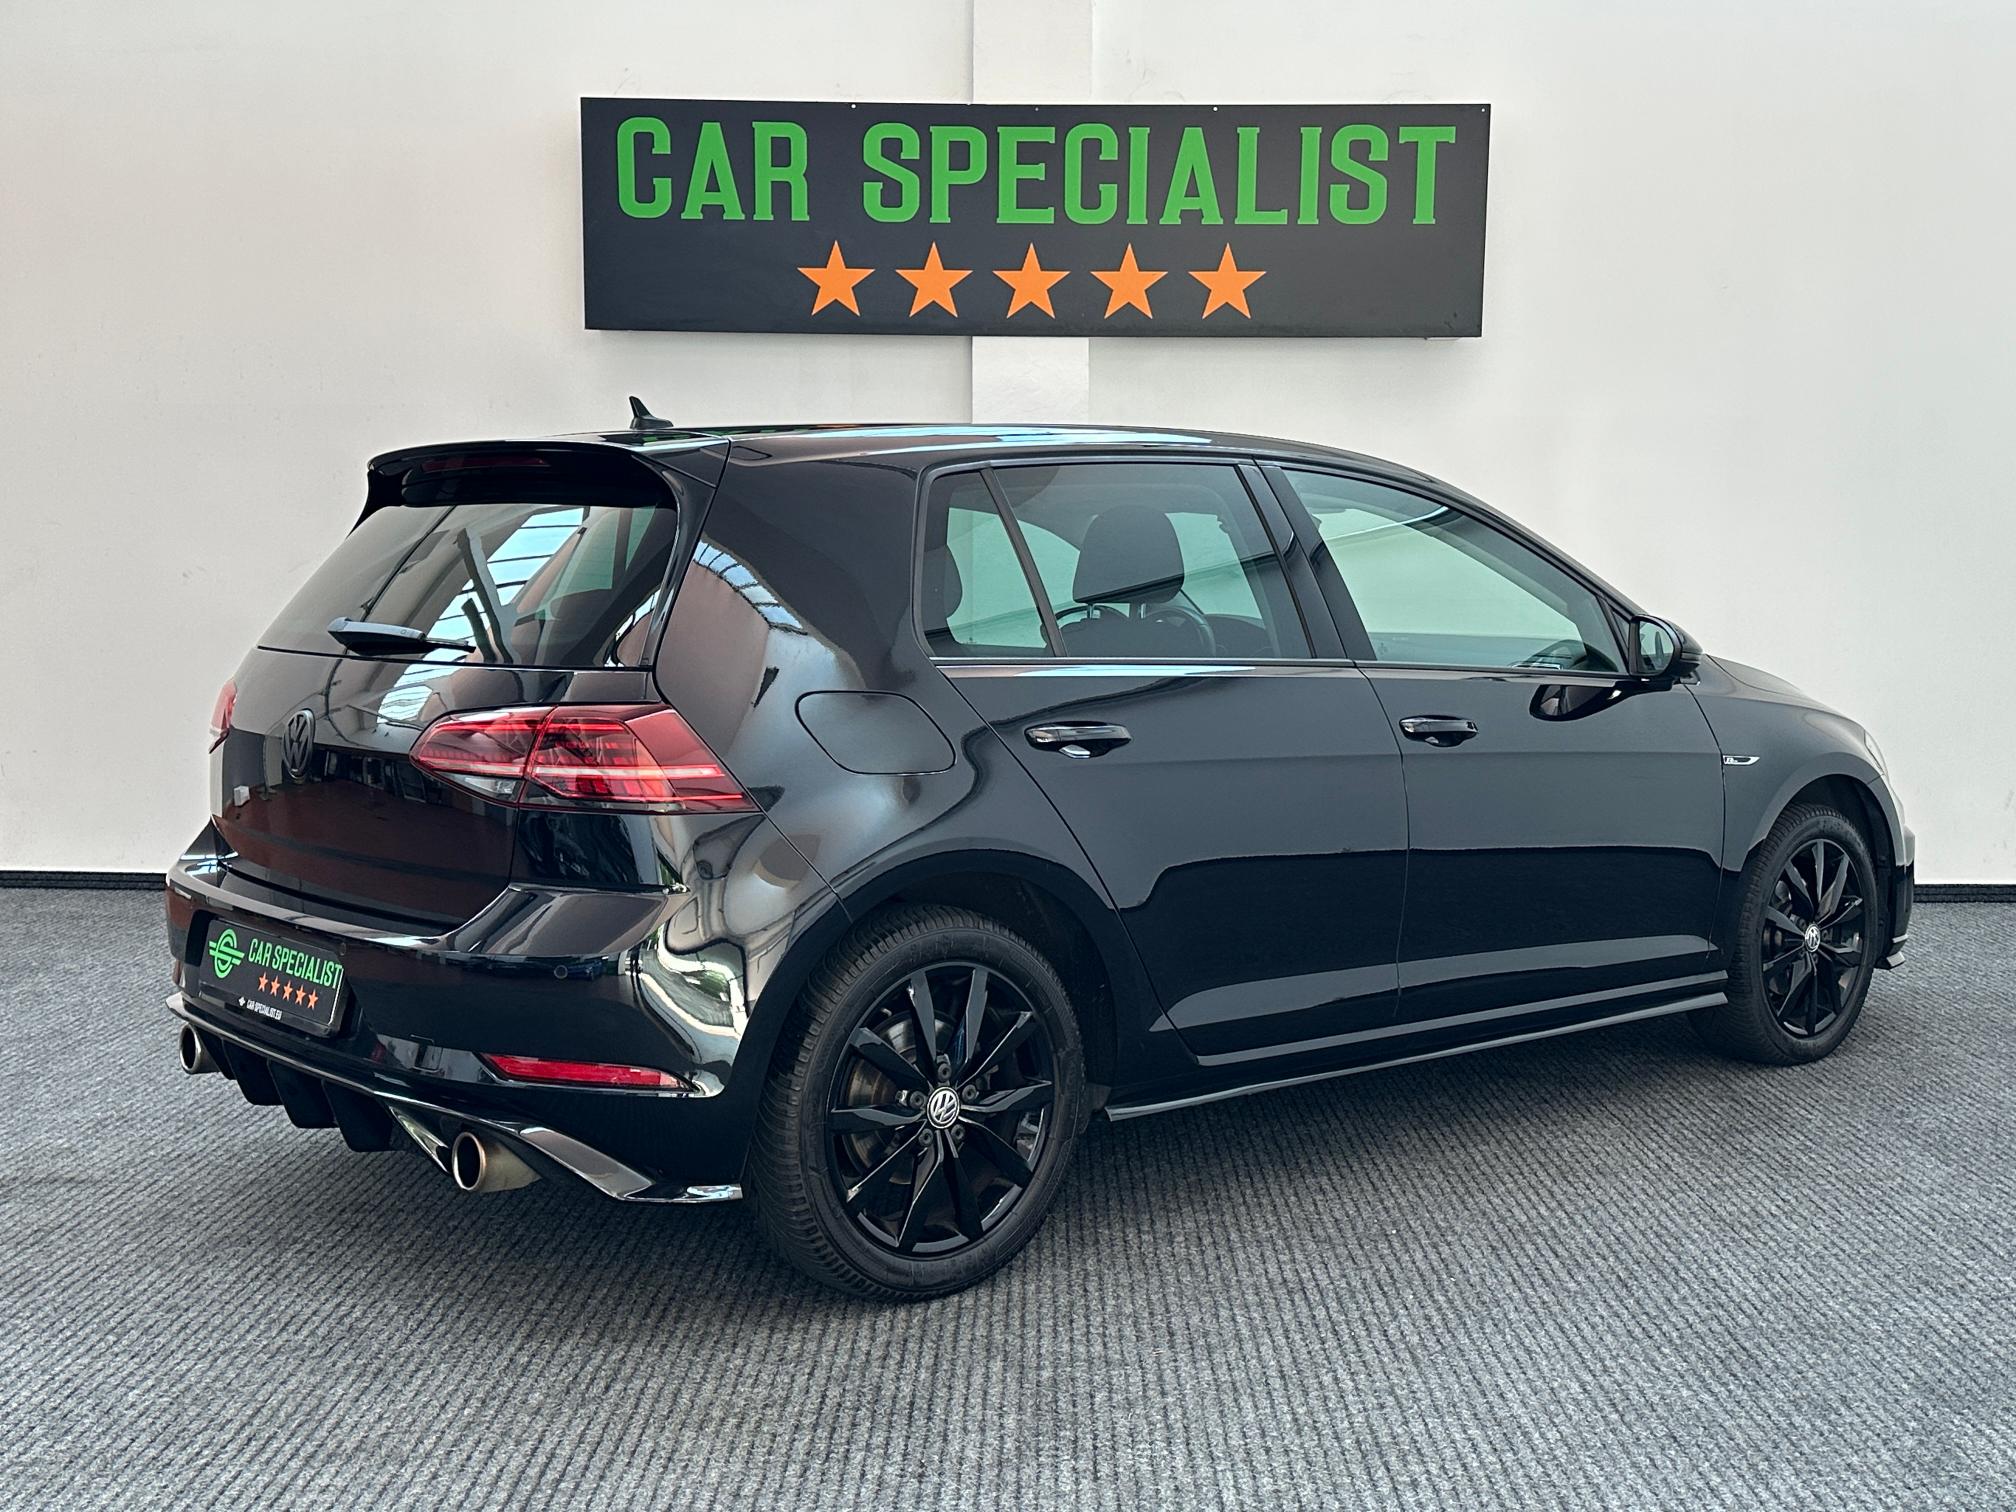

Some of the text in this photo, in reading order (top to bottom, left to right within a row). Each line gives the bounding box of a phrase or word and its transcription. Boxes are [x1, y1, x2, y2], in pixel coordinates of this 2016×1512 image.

[616, 116, 1457, 225] CAR SPECIALIST
[248, 938, 343, 990] CAR SPECIALIST
